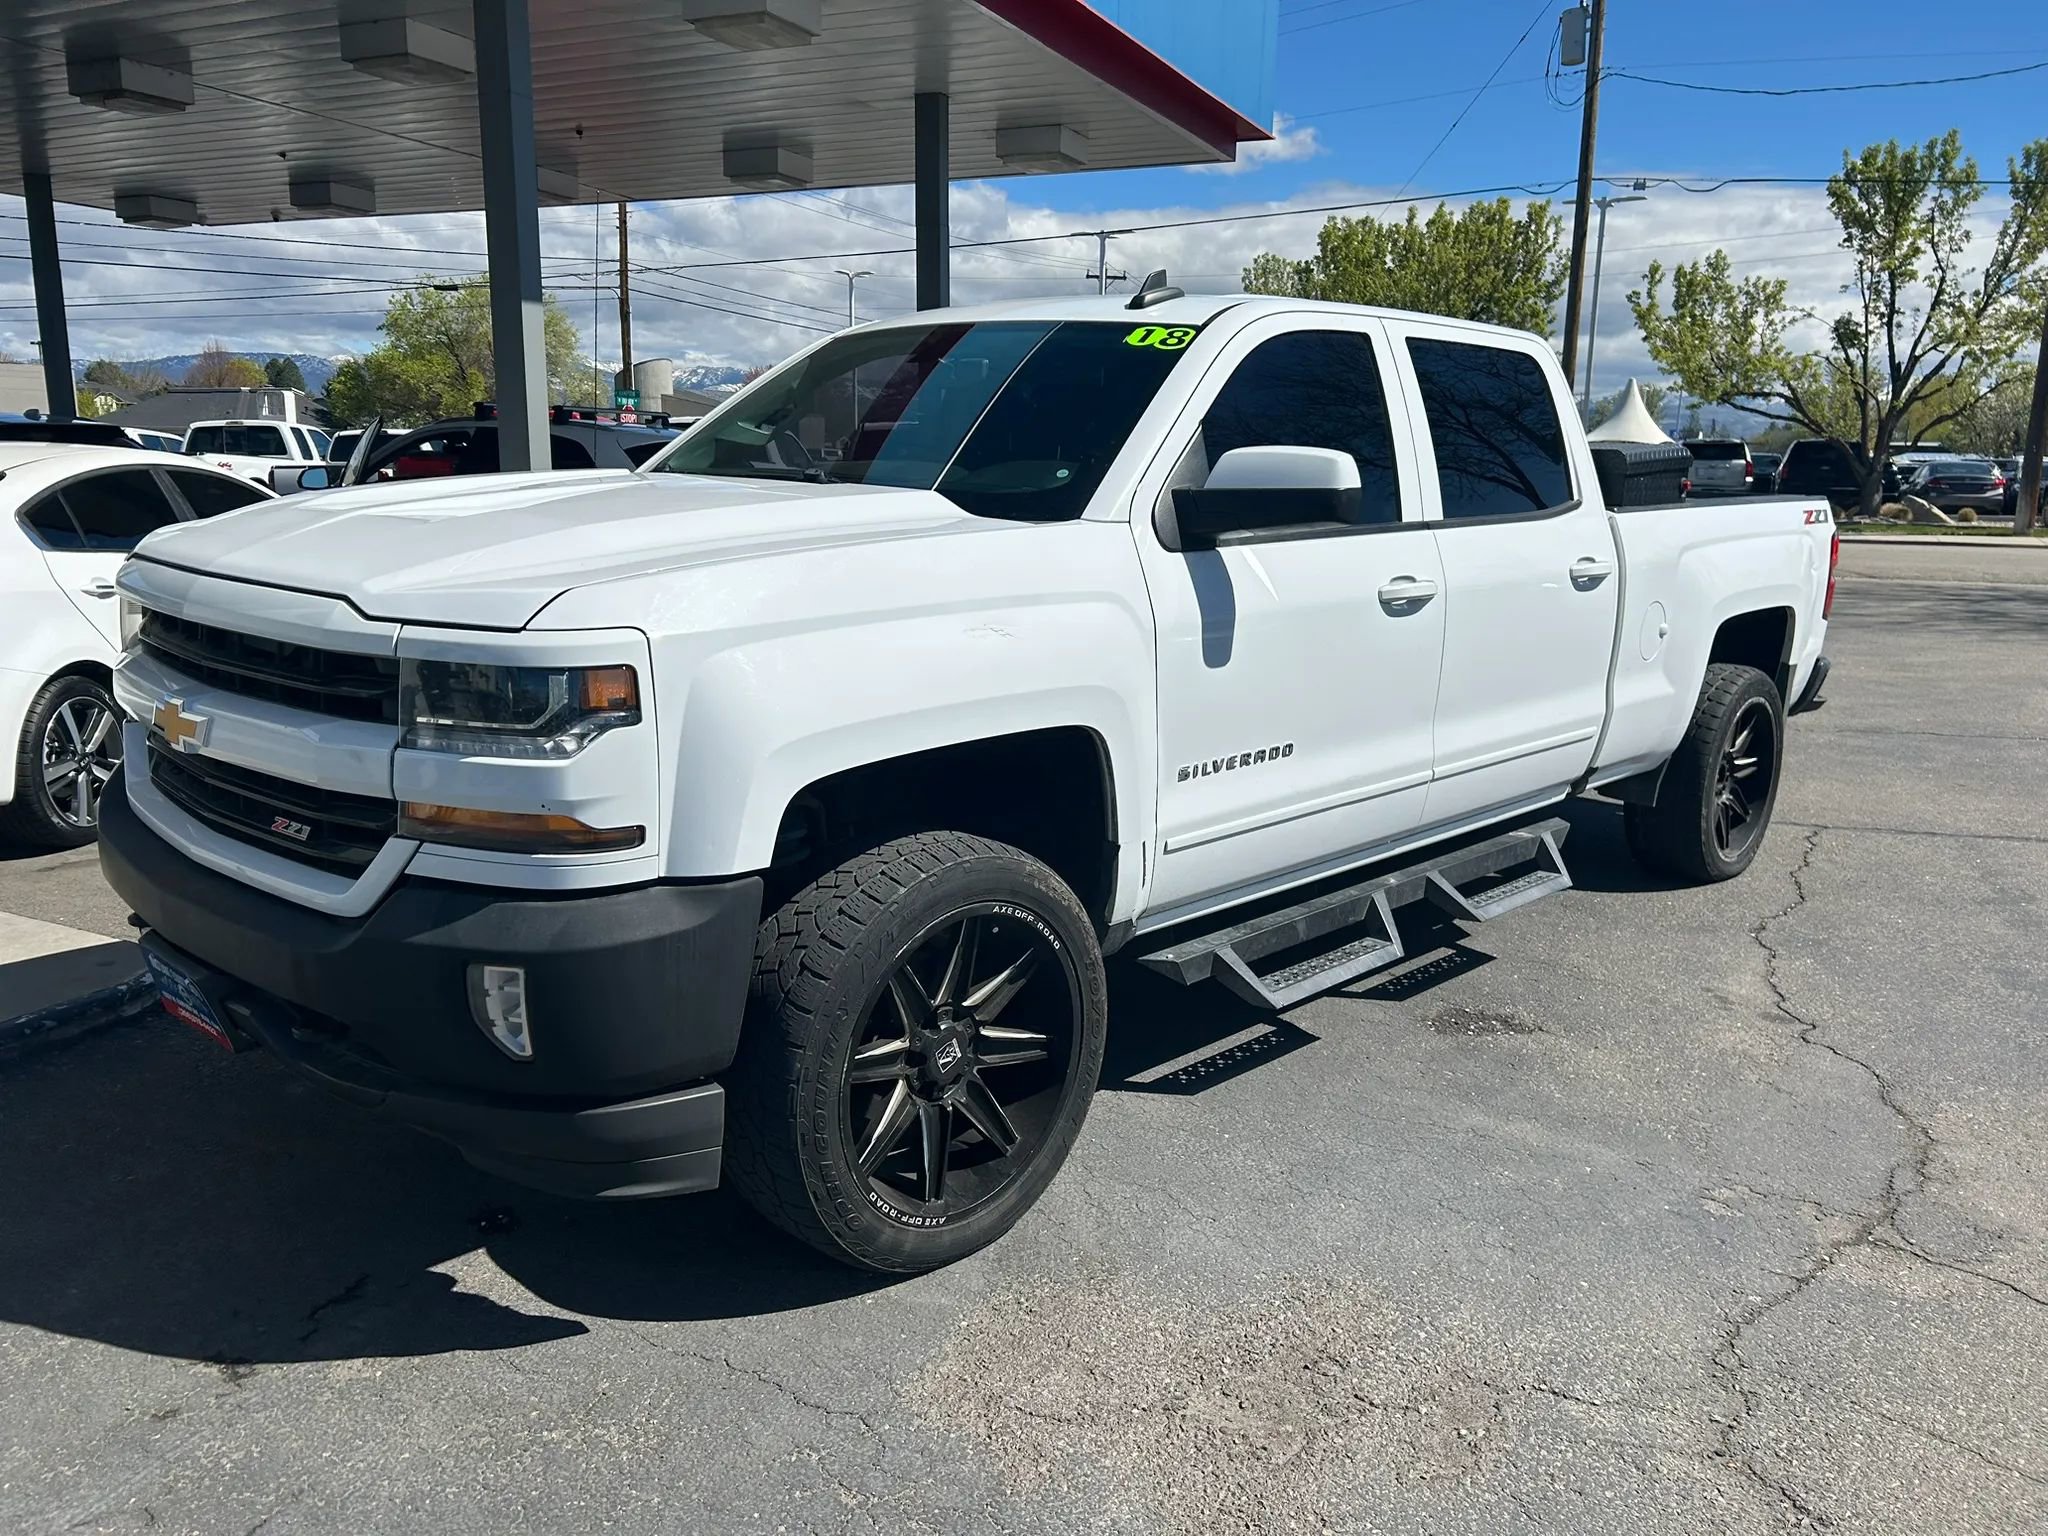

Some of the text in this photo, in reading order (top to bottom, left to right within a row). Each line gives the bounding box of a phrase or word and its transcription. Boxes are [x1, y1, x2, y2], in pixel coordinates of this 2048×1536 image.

[1136, 328, 1191, 347] 18
[620, 413, 637, 423] STOP
[1803, 509, 1828, 525] Z71
[1177, 742, 1294, 782] SILVERADO
[271, 816, 311, 841] Z71
[992, 905, 1060, 950] AXE OFF-ROAD
[818, 1161, 867, 1233] OPEN
[869, 1191, 946, 1226] AXE OFF-ROAD
